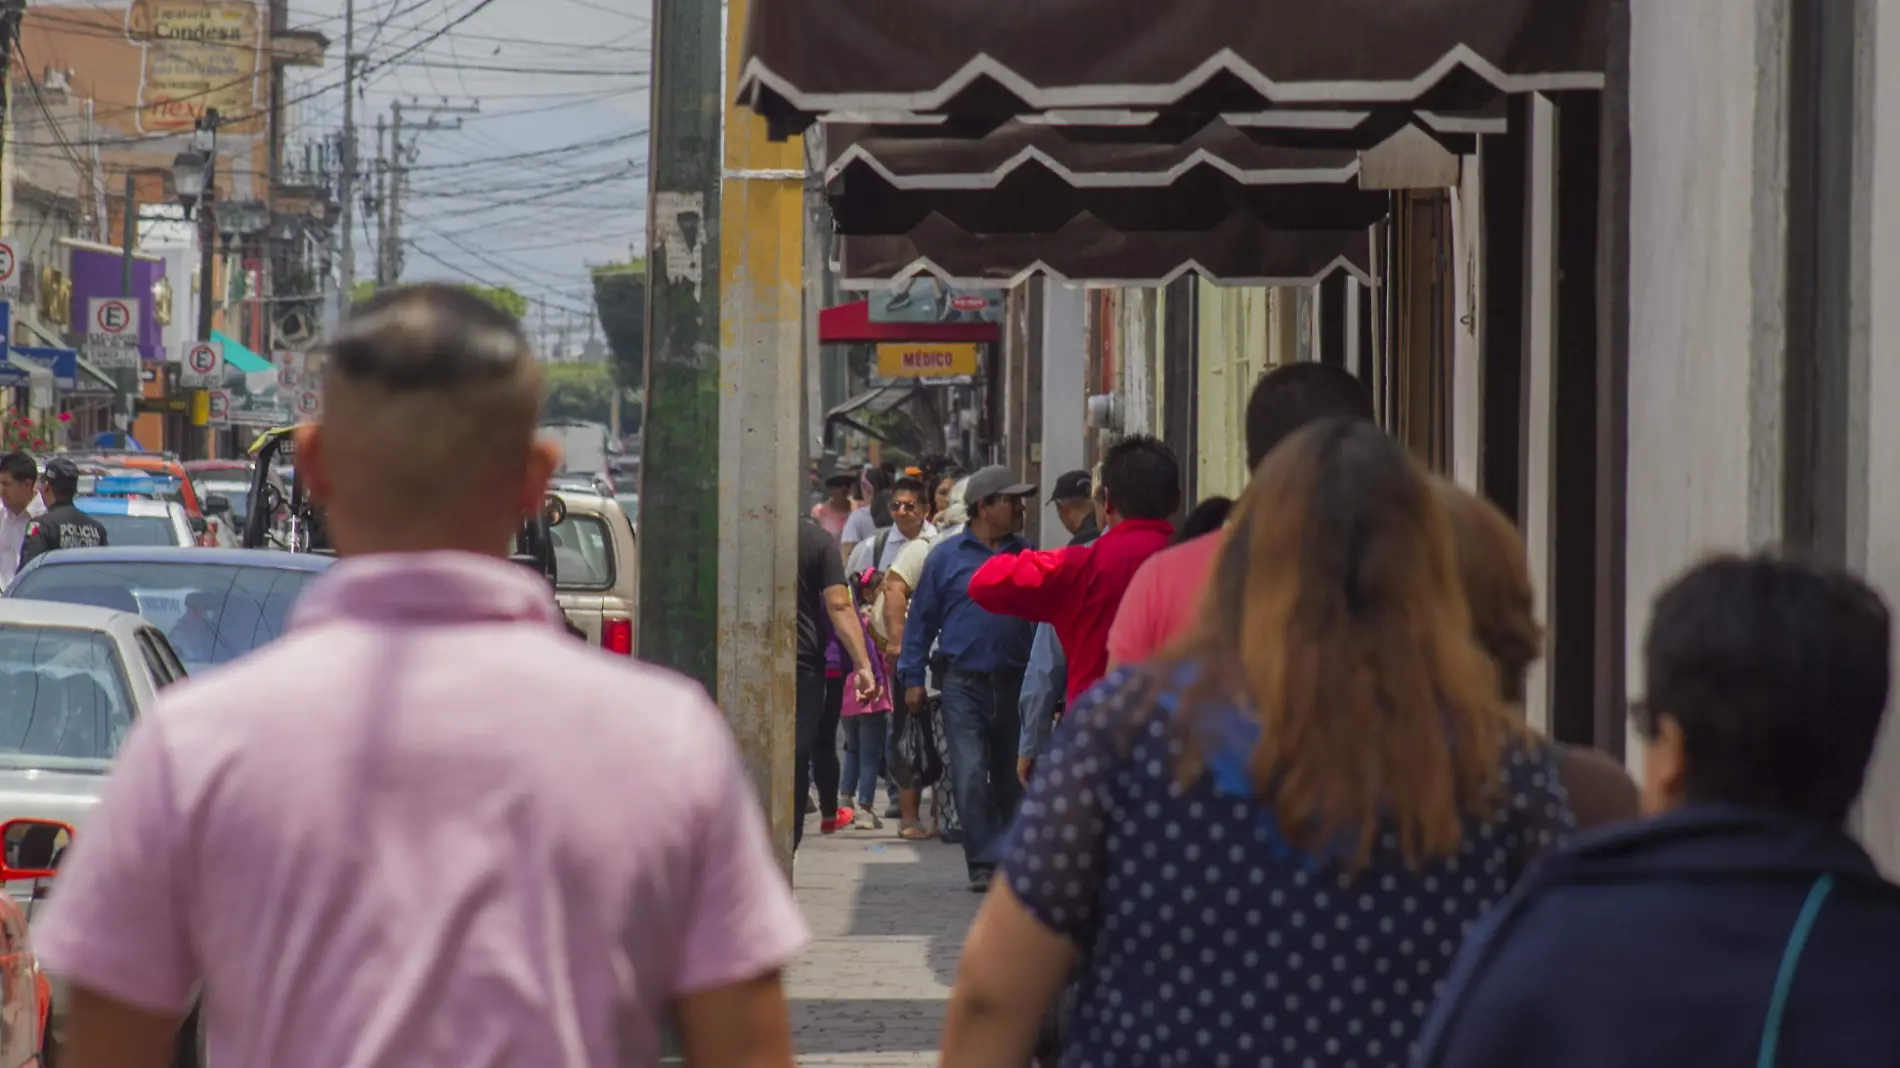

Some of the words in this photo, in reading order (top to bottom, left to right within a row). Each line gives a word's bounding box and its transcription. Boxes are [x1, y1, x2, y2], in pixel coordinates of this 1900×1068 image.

[154, 21, 240, 41] Condesa
[106, 306, 121, 328] E
[196, 350, 208, 369] E
[903, 349, 952, 368] MÉDICO
